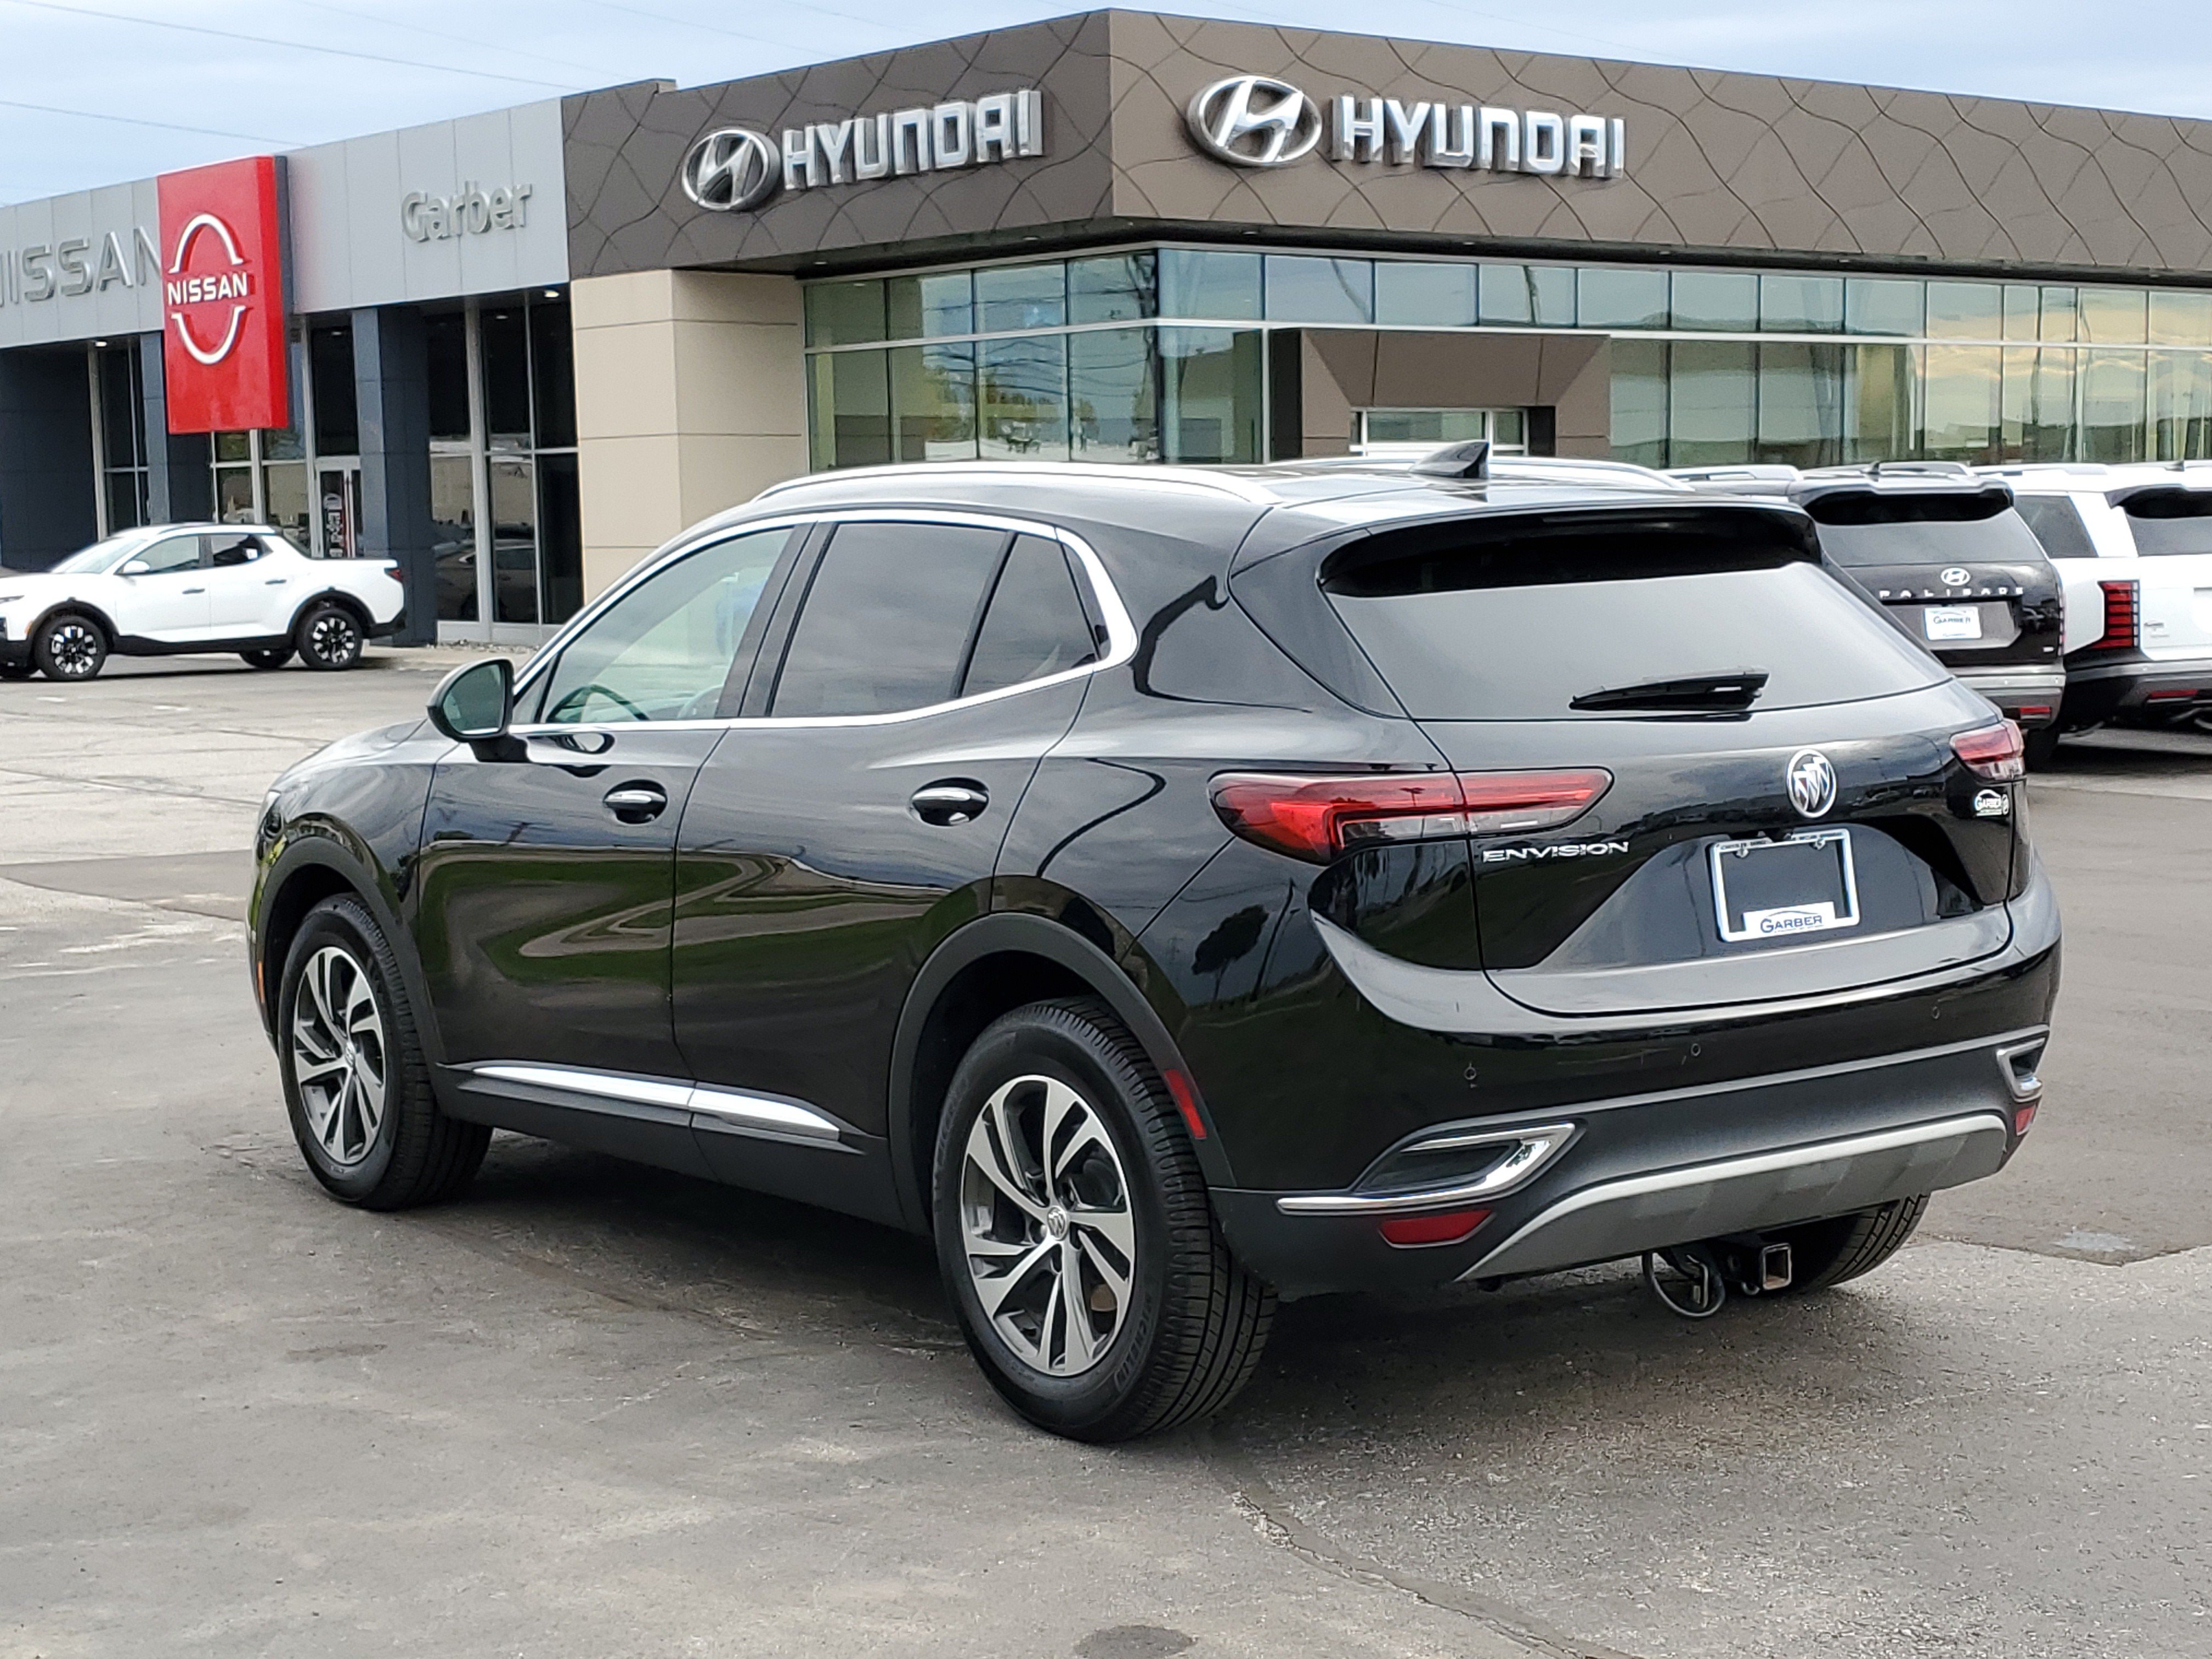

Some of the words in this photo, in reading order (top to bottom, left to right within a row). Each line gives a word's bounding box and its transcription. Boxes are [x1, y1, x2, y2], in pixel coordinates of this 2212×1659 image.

[782, 89, 1042, 190] HYUNDAI
[1331, 95, 1626, 179] HYUNDAI
[401, 180, 533, 242] Garber
[0, 225, 162, 308] ISSAN
[167, 272, 248, 307] NISSAN
[1878, 586, 2024, 599] PALISADE
[1482, 842, 1629, 863] ENVISION
[1760, 915, 1823, 933] GARBER
